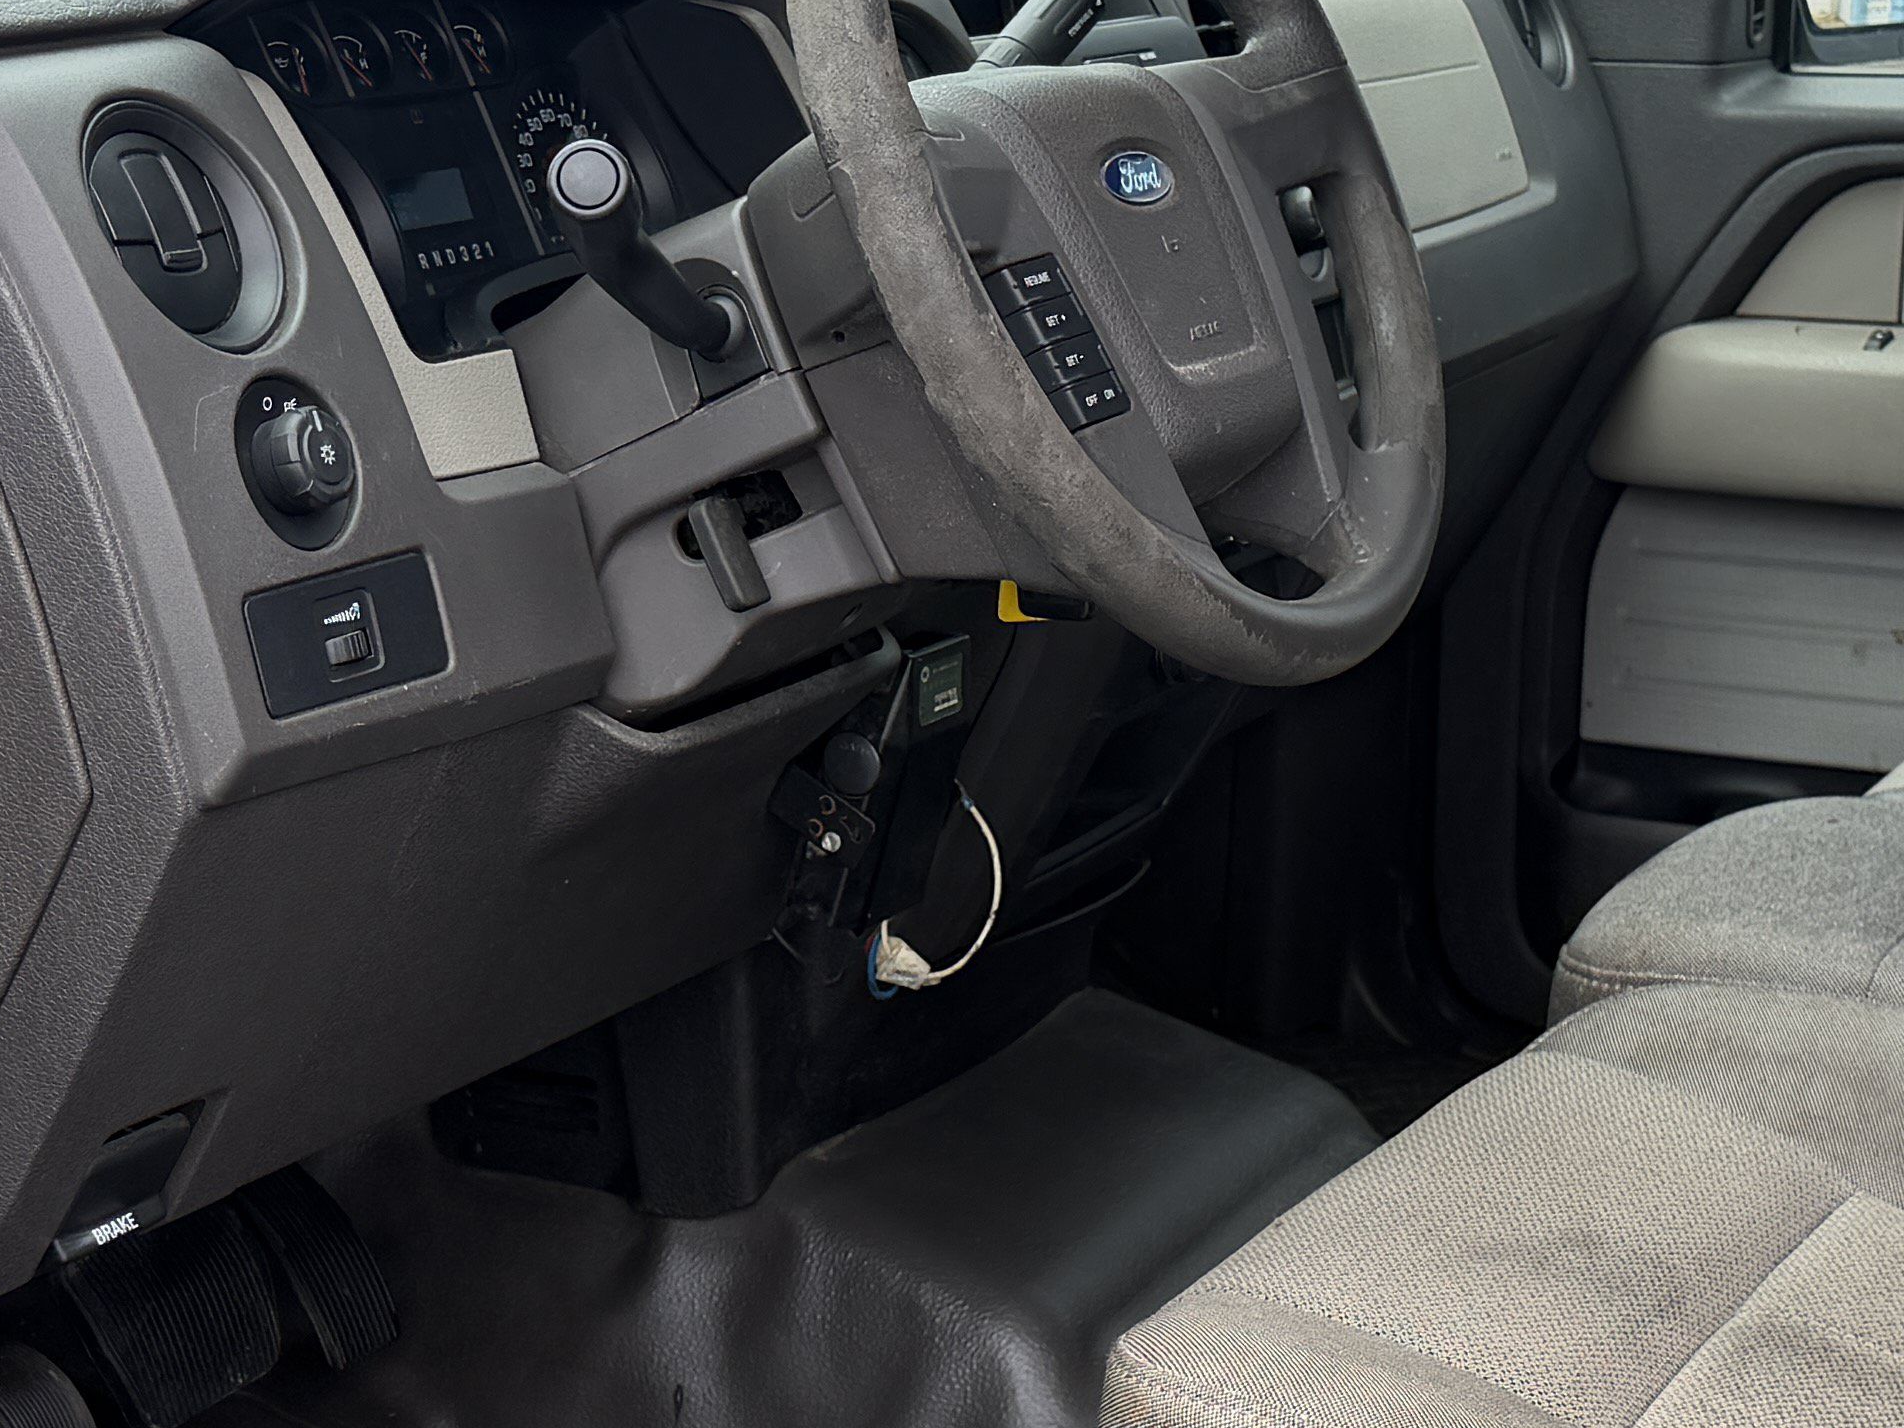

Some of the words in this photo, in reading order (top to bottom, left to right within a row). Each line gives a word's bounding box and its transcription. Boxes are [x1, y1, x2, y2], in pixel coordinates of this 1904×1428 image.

[1118, 158, 1162, 193] Ford
[472, 243, 483, 260] 2
[91, 1212, 139, 1245] BRAKE
